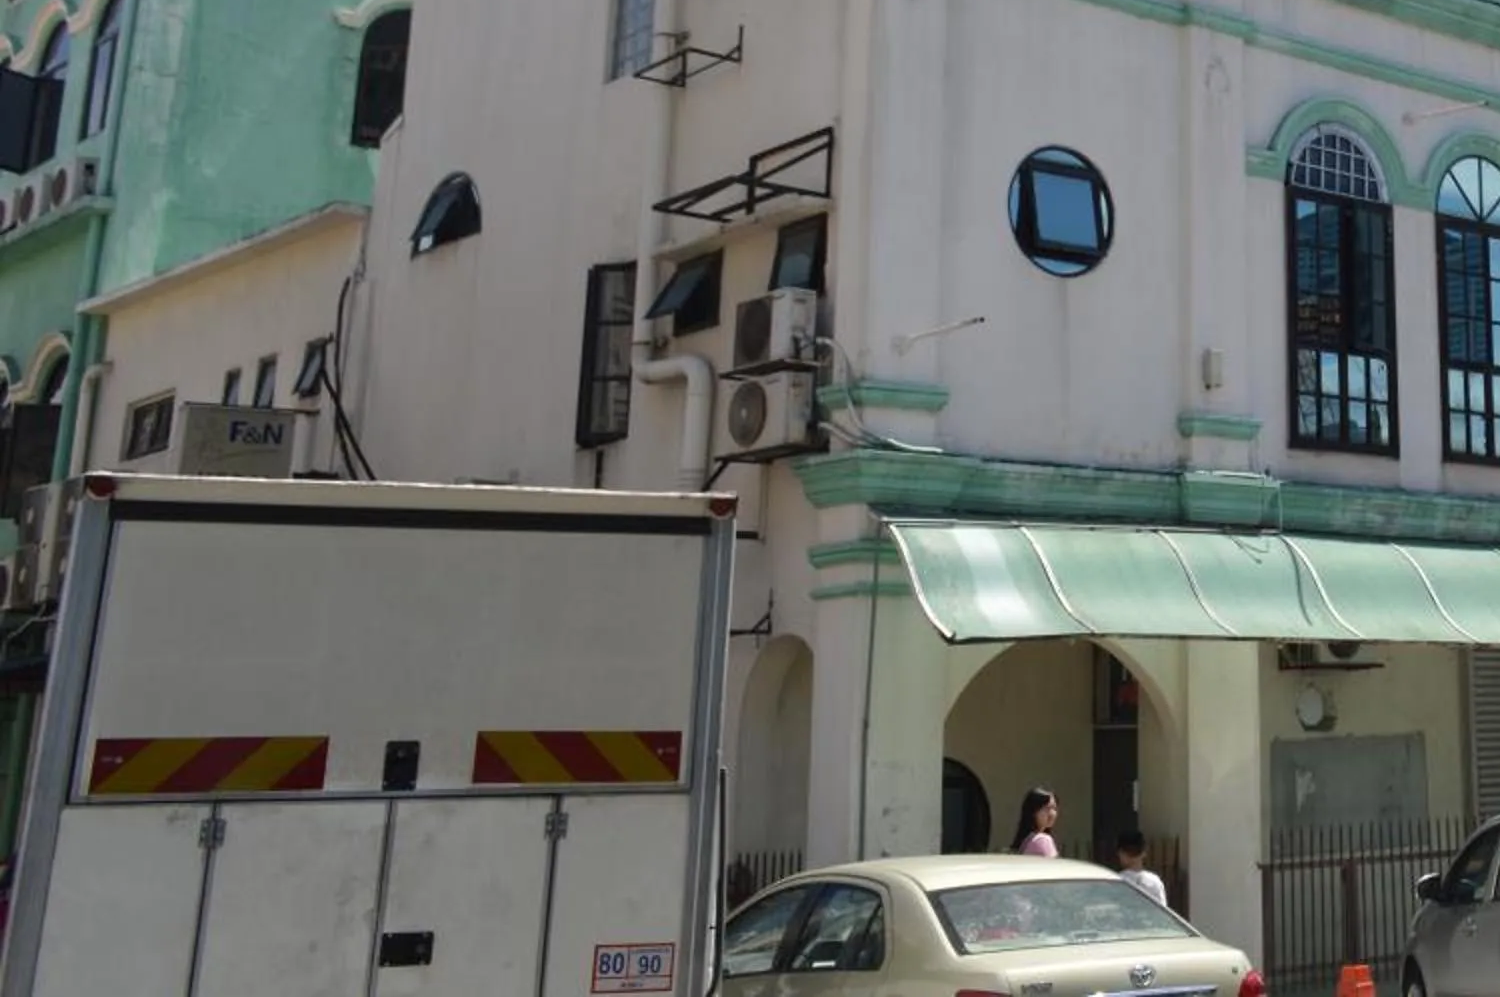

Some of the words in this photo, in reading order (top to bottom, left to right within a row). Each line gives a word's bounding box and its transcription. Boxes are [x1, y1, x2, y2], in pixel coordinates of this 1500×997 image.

[229, 421, 284, 444] F&N
[599, 952, 625, 974] 80
[638, 954, 662, 974] 90
